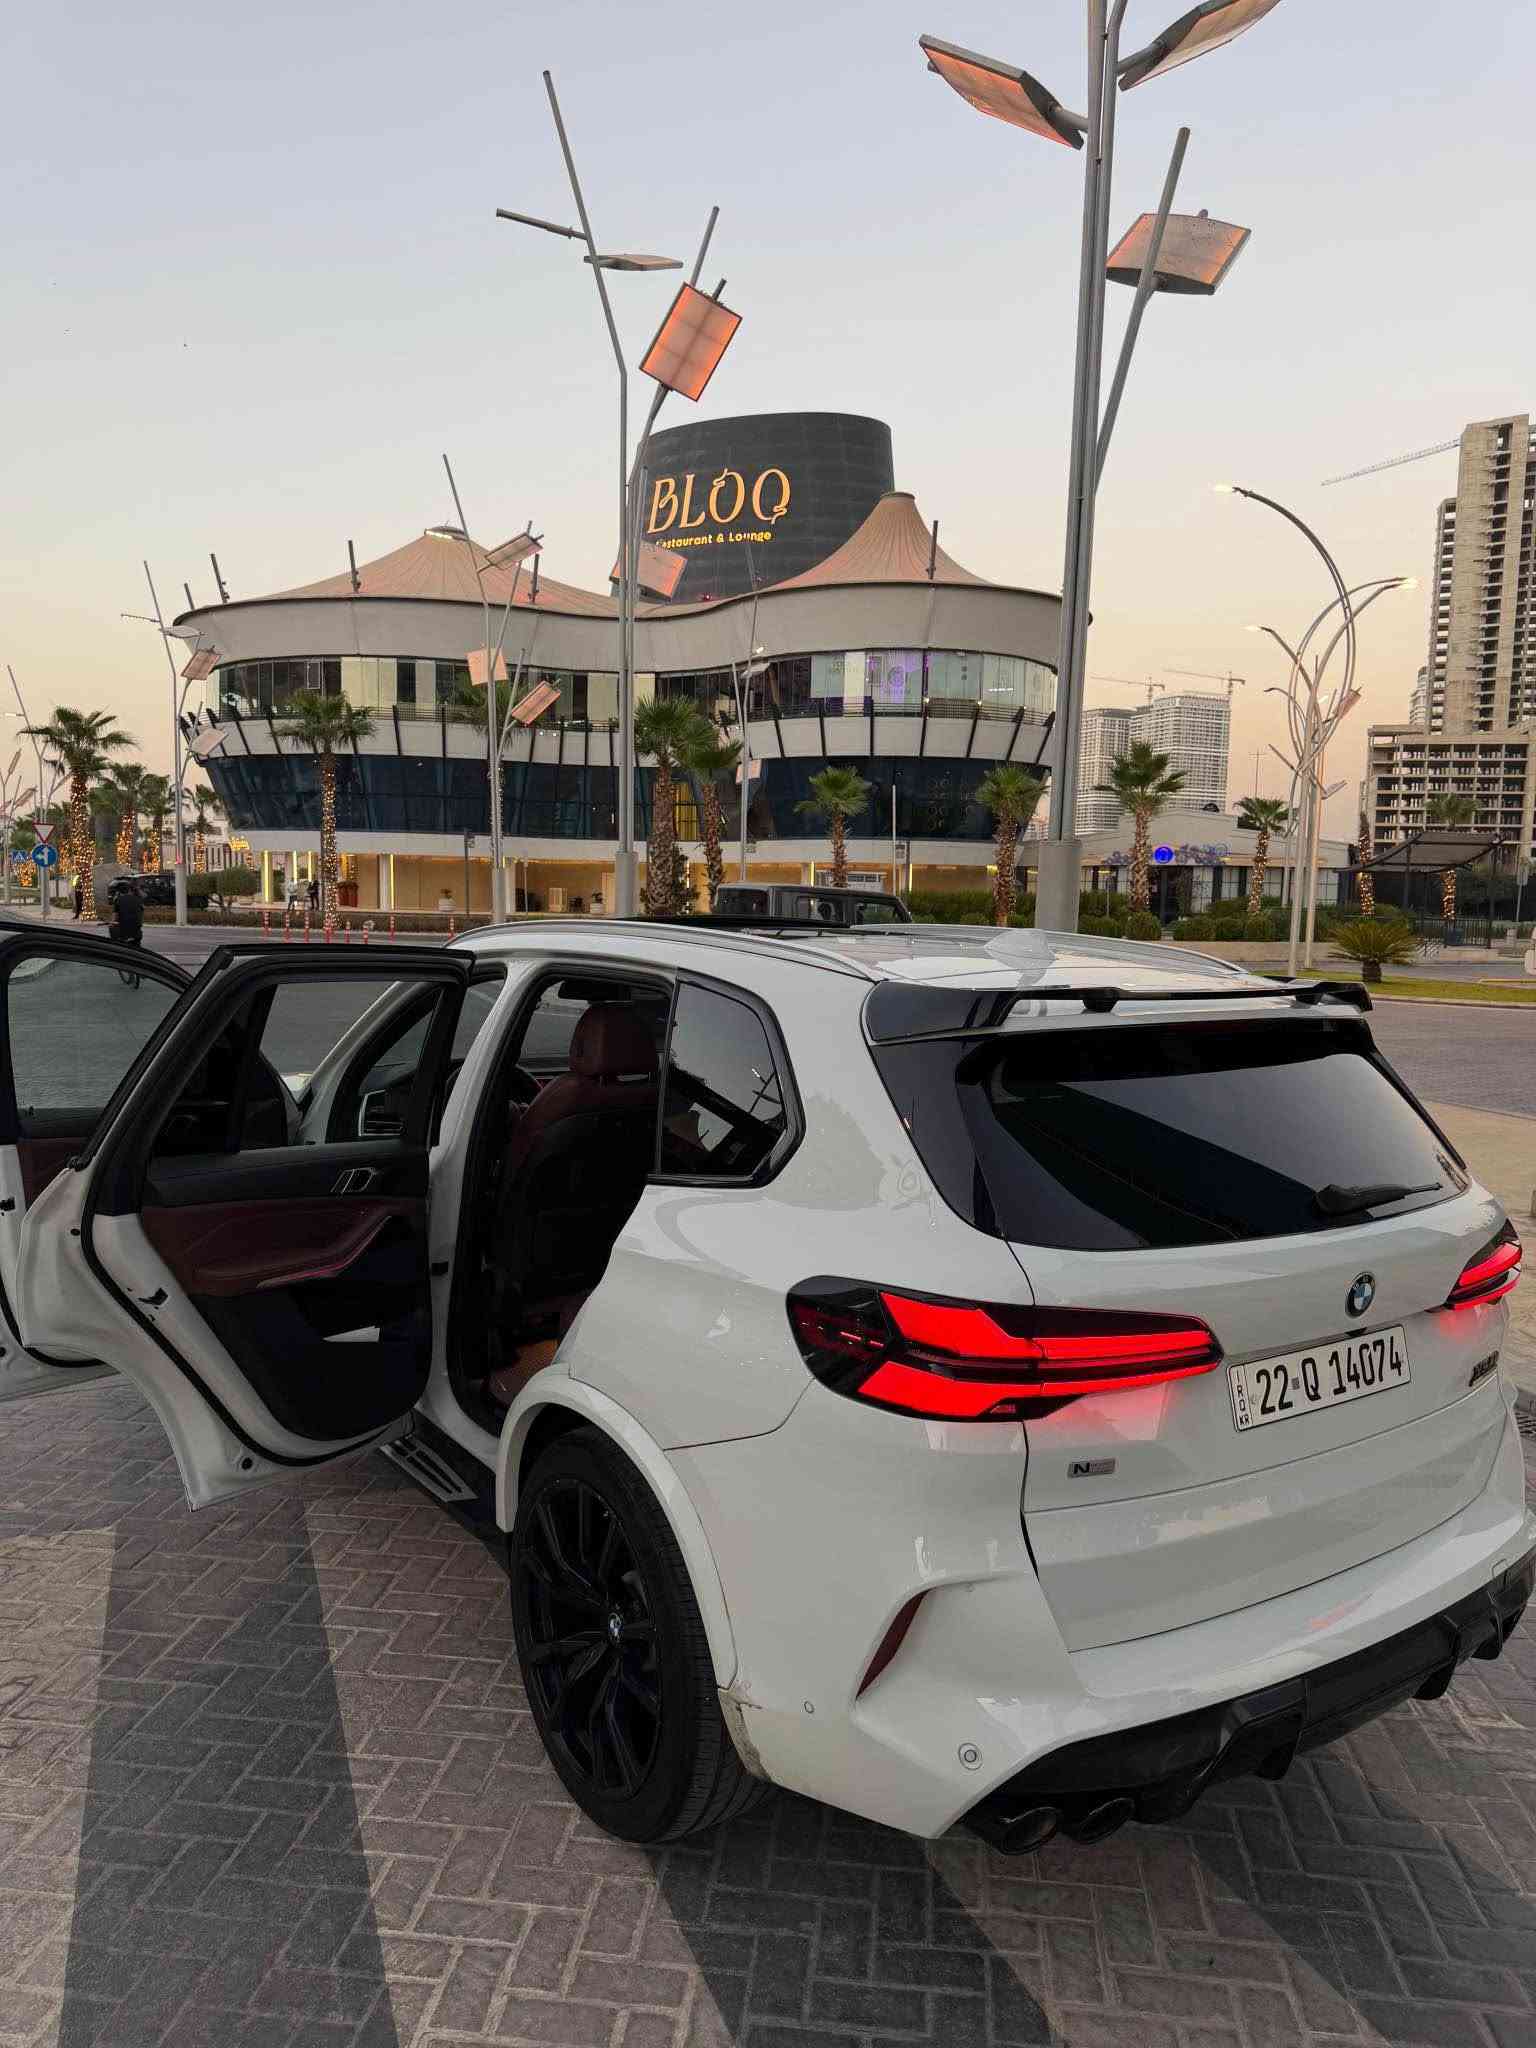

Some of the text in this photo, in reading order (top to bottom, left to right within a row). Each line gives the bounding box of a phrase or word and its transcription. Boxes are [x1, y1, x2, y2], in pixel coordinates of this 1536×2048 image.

[647, 468, 791, 534] BLOQ
[716, 532, 724, 544] &
[728, 530, 772, 542] Lounge
[1256, 1335, 1402, 1415] 22 Q 14074
